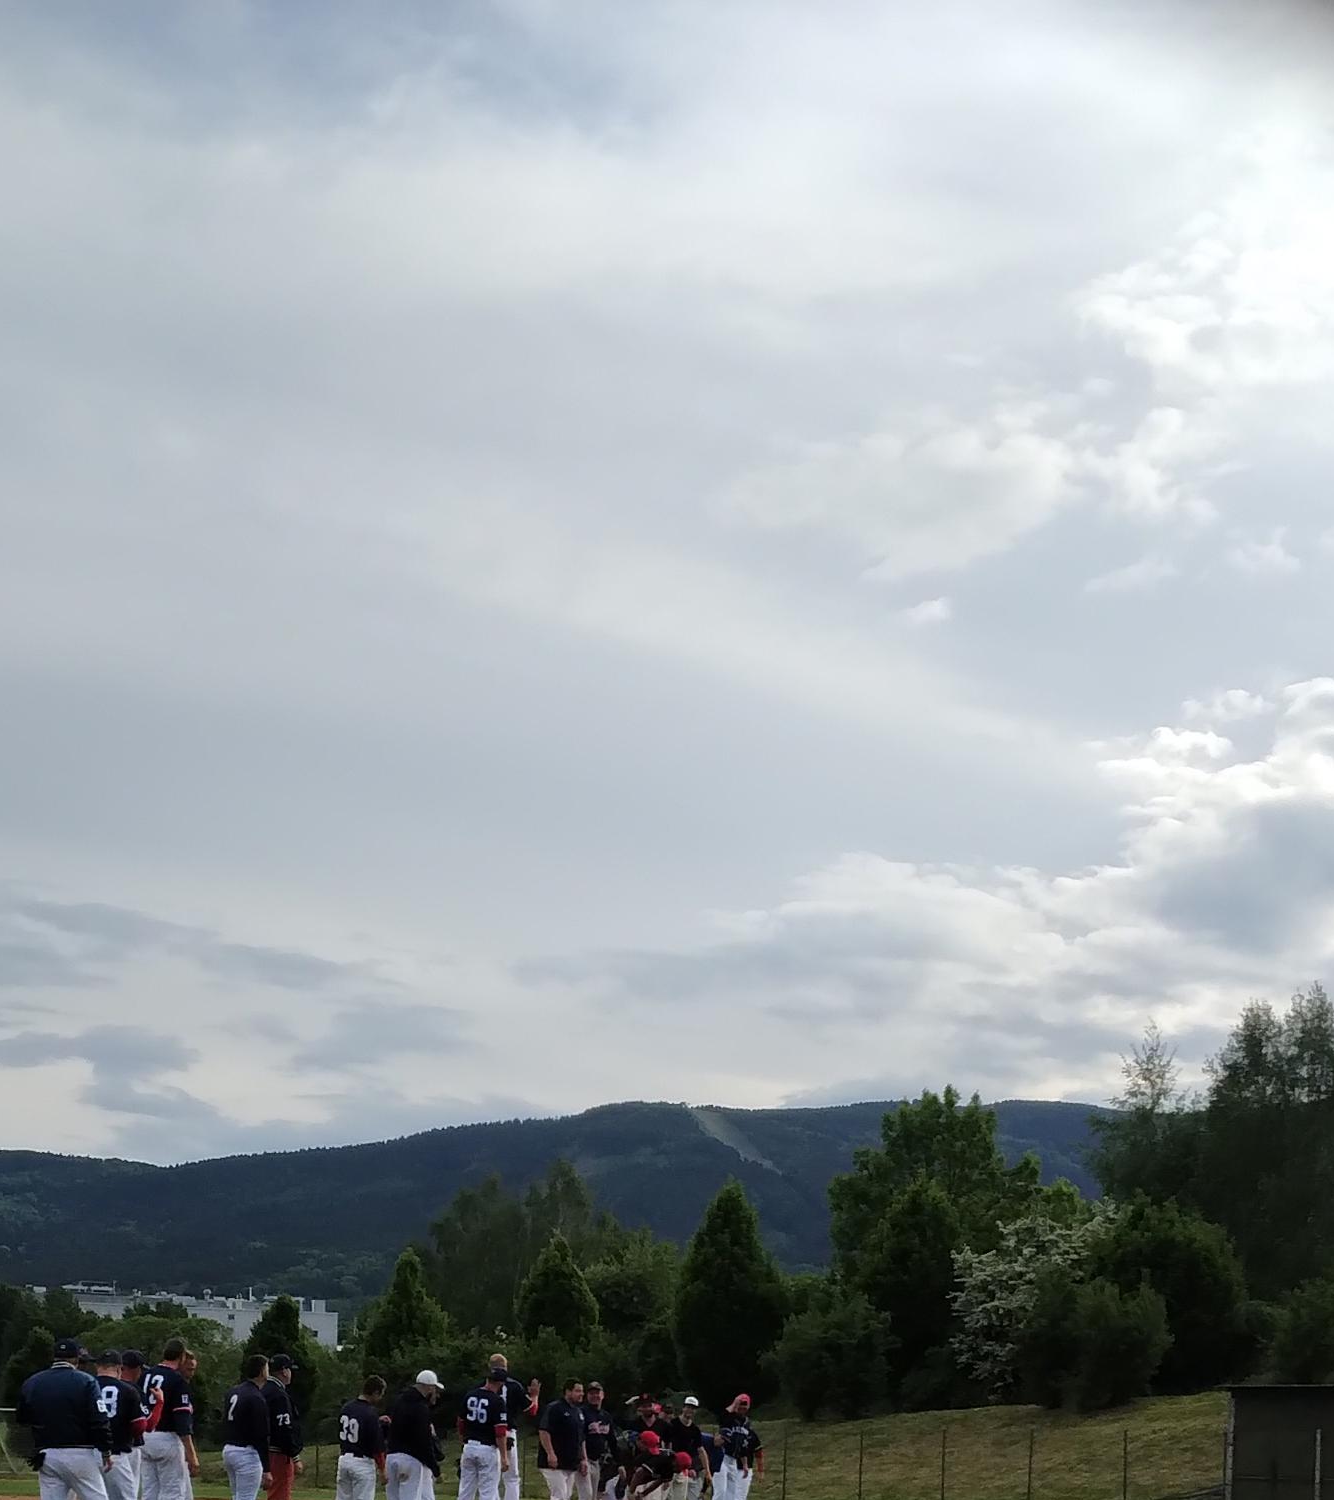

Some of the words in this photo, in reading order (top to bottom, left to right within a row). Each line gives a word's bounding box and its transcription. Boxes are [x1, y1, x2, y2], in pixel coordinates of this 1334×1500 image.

[276, 1413, 291, 1426] 73
[466, 1396, 489, 1424] 96
[339, 1414, 360, 1444] 39
